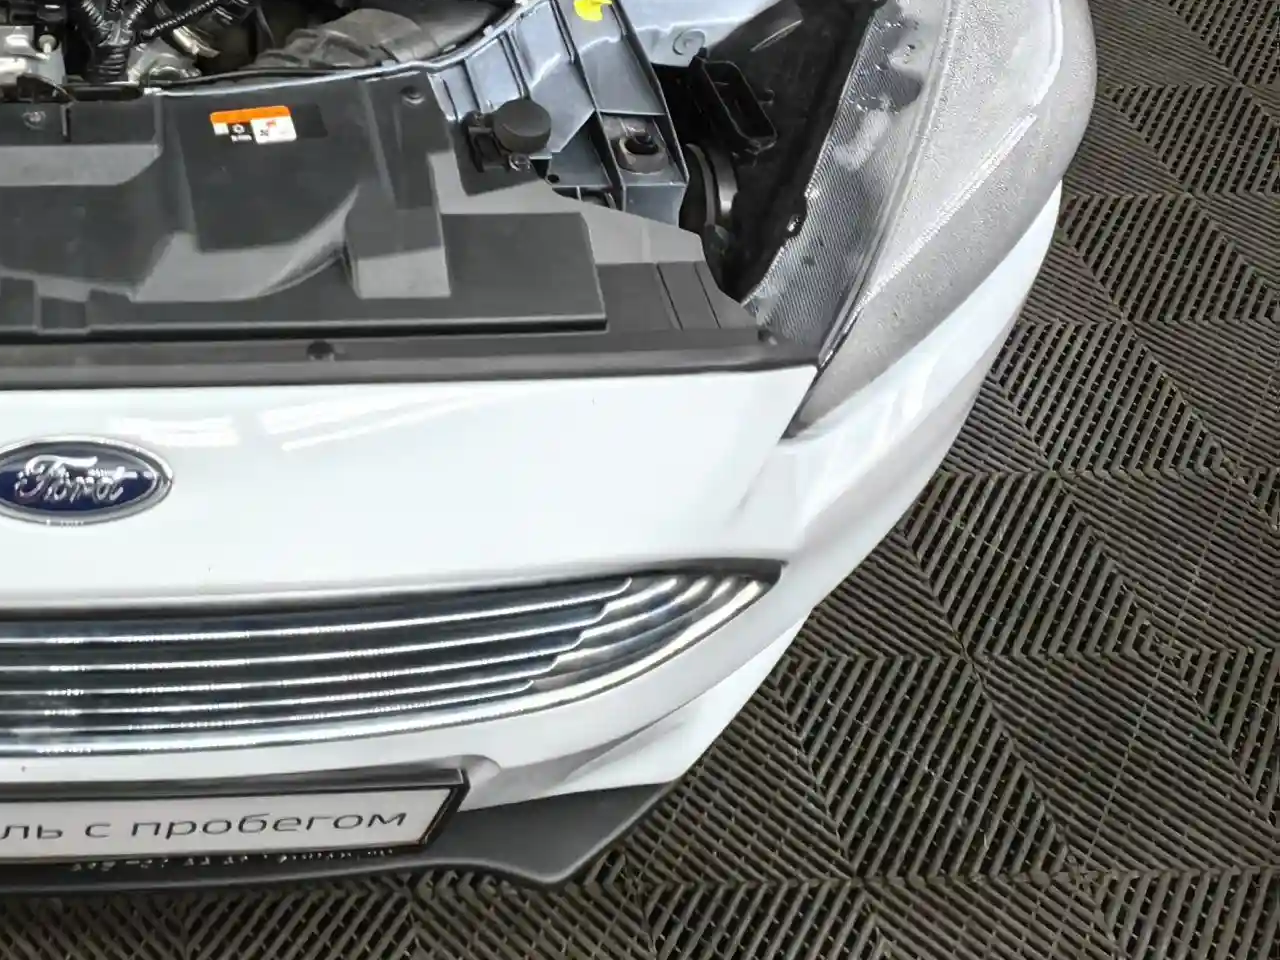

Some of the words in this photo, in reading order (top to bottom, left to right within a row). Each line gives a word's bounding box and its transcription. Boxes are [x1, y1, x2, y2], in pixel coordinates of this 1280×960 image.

[15, 454, 138, 503] Ford
[84, 821, 112, 839] с
[130, 811, 407, 840] пробегом
